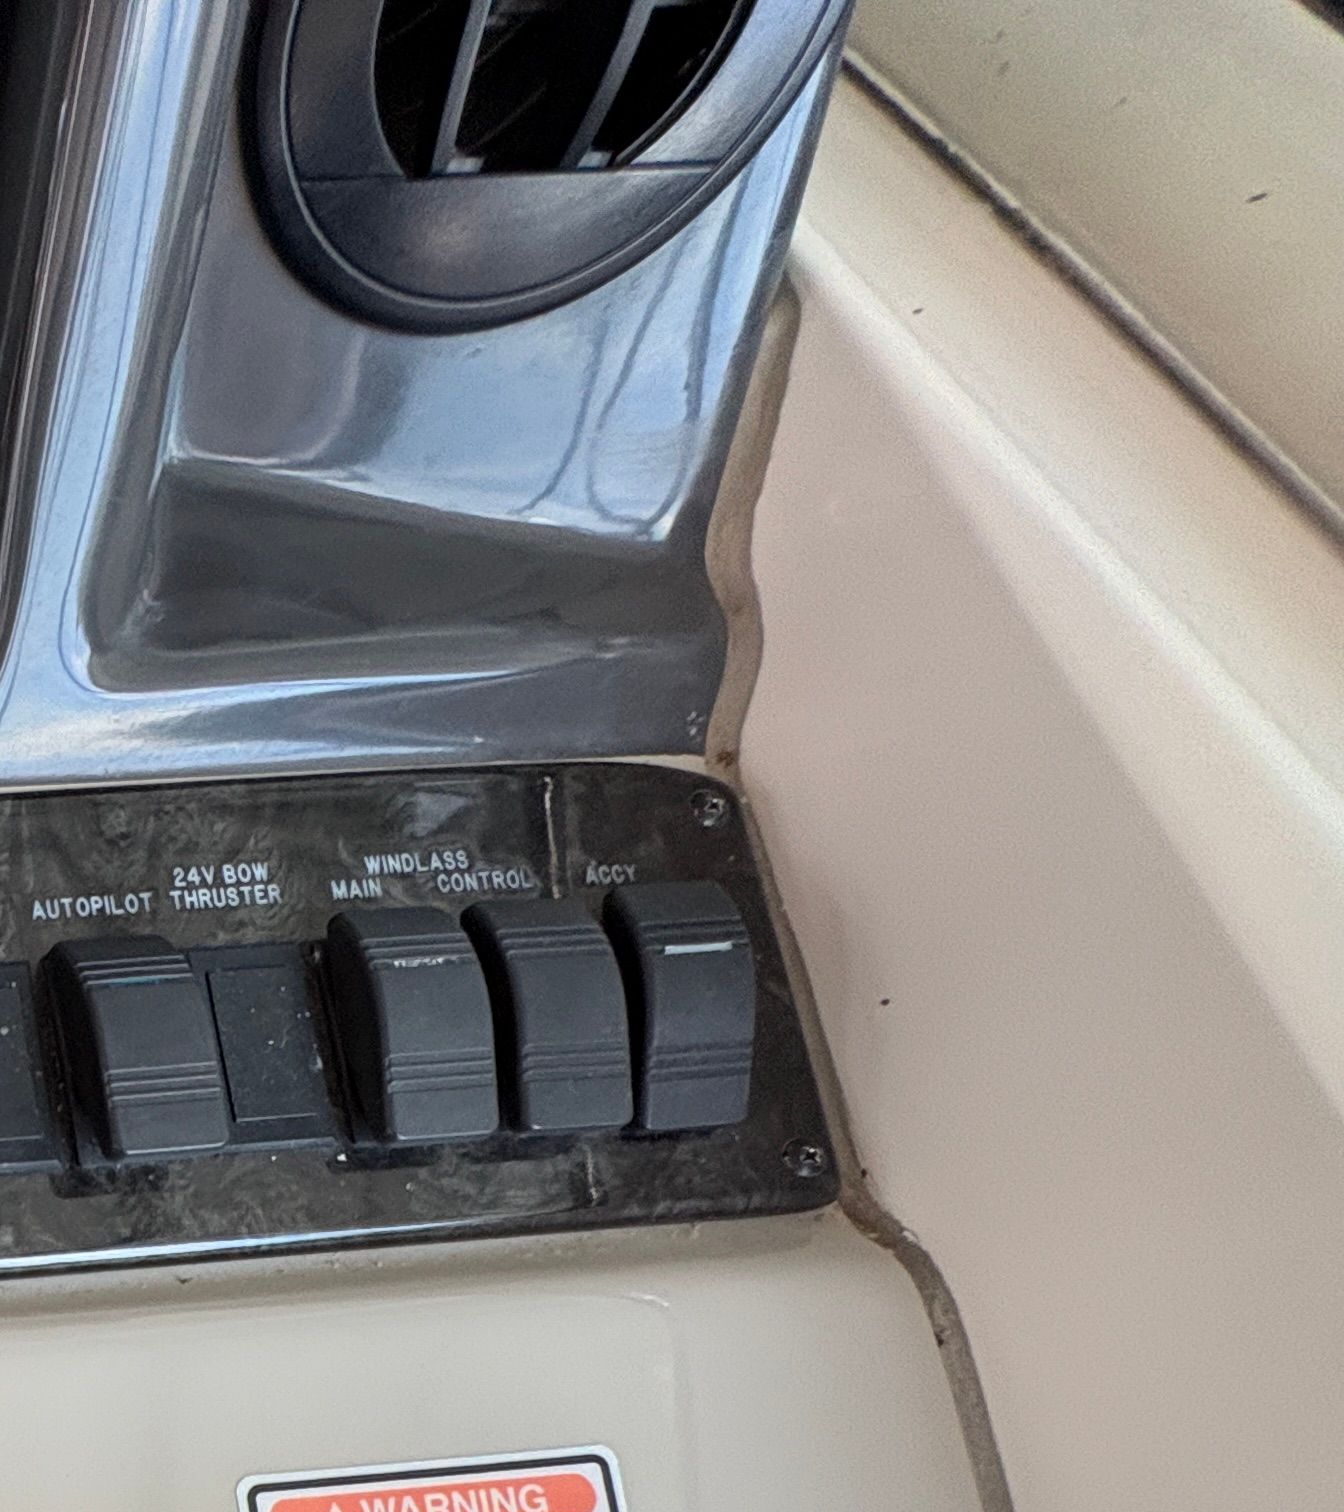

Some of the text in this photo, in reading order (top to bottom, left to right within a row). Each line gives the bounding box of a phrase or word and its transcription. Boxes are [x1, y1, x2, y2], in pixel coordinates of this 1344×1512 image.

[173, 862, 269, 888] 24V BOW
[363, 849, 469, 876] WINDLASS
[585, 862, 637, 885] ACCY
[169, 884, 282, 911] THRUSTER
[330, 867, 532, 901] MAIN CONTROL
[32, 892, 154, 921] AUTOPILOT
